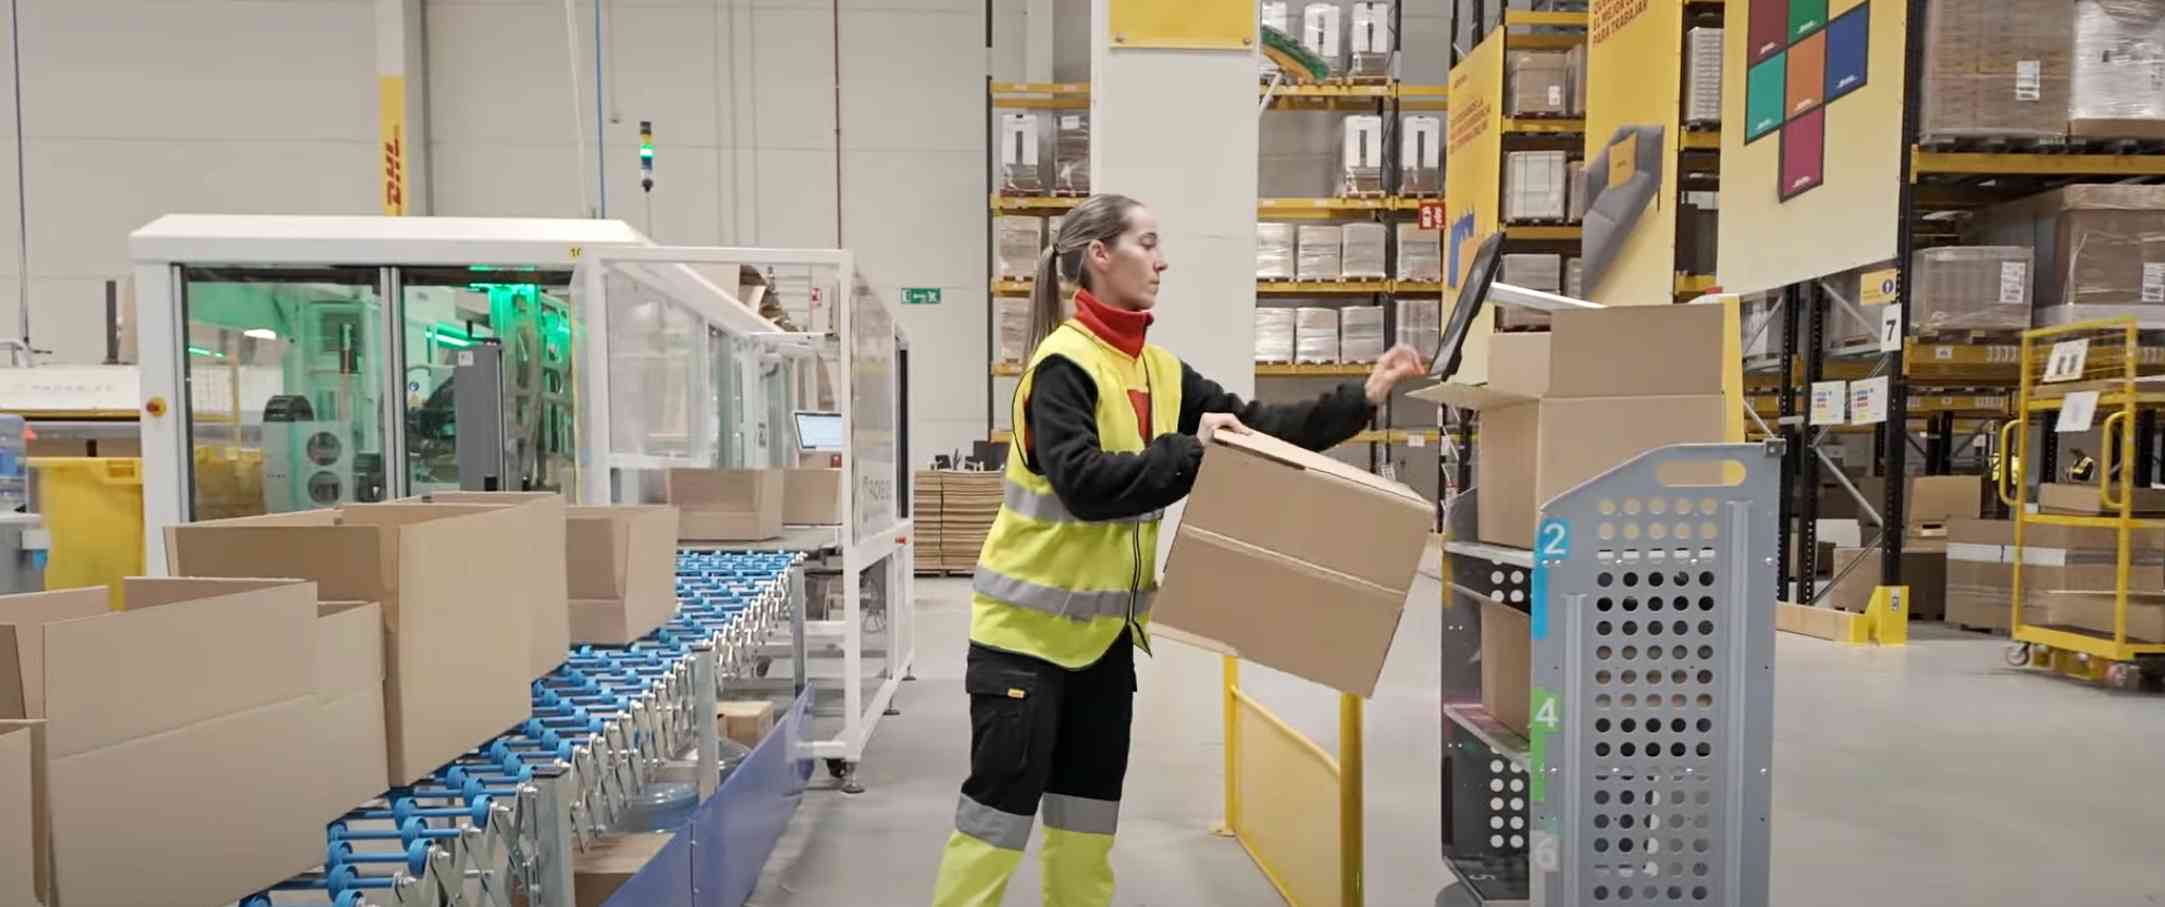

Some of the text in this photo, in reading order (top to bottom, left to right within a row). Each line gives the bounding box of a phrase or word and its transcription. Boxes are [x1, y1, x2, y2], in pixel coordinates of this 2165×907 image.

[1592, 26, 1610, 44] PARA
[1611, 0, 1648, 30] TRABAJAR
[385, 138, 401, 206] DHL
[1886, 319, 1897, 342] 7
[1543, 523, 1567, 555] 2
[1535, 697, 1559, 729] 4
[1534, 836, 1559, 870] 6
